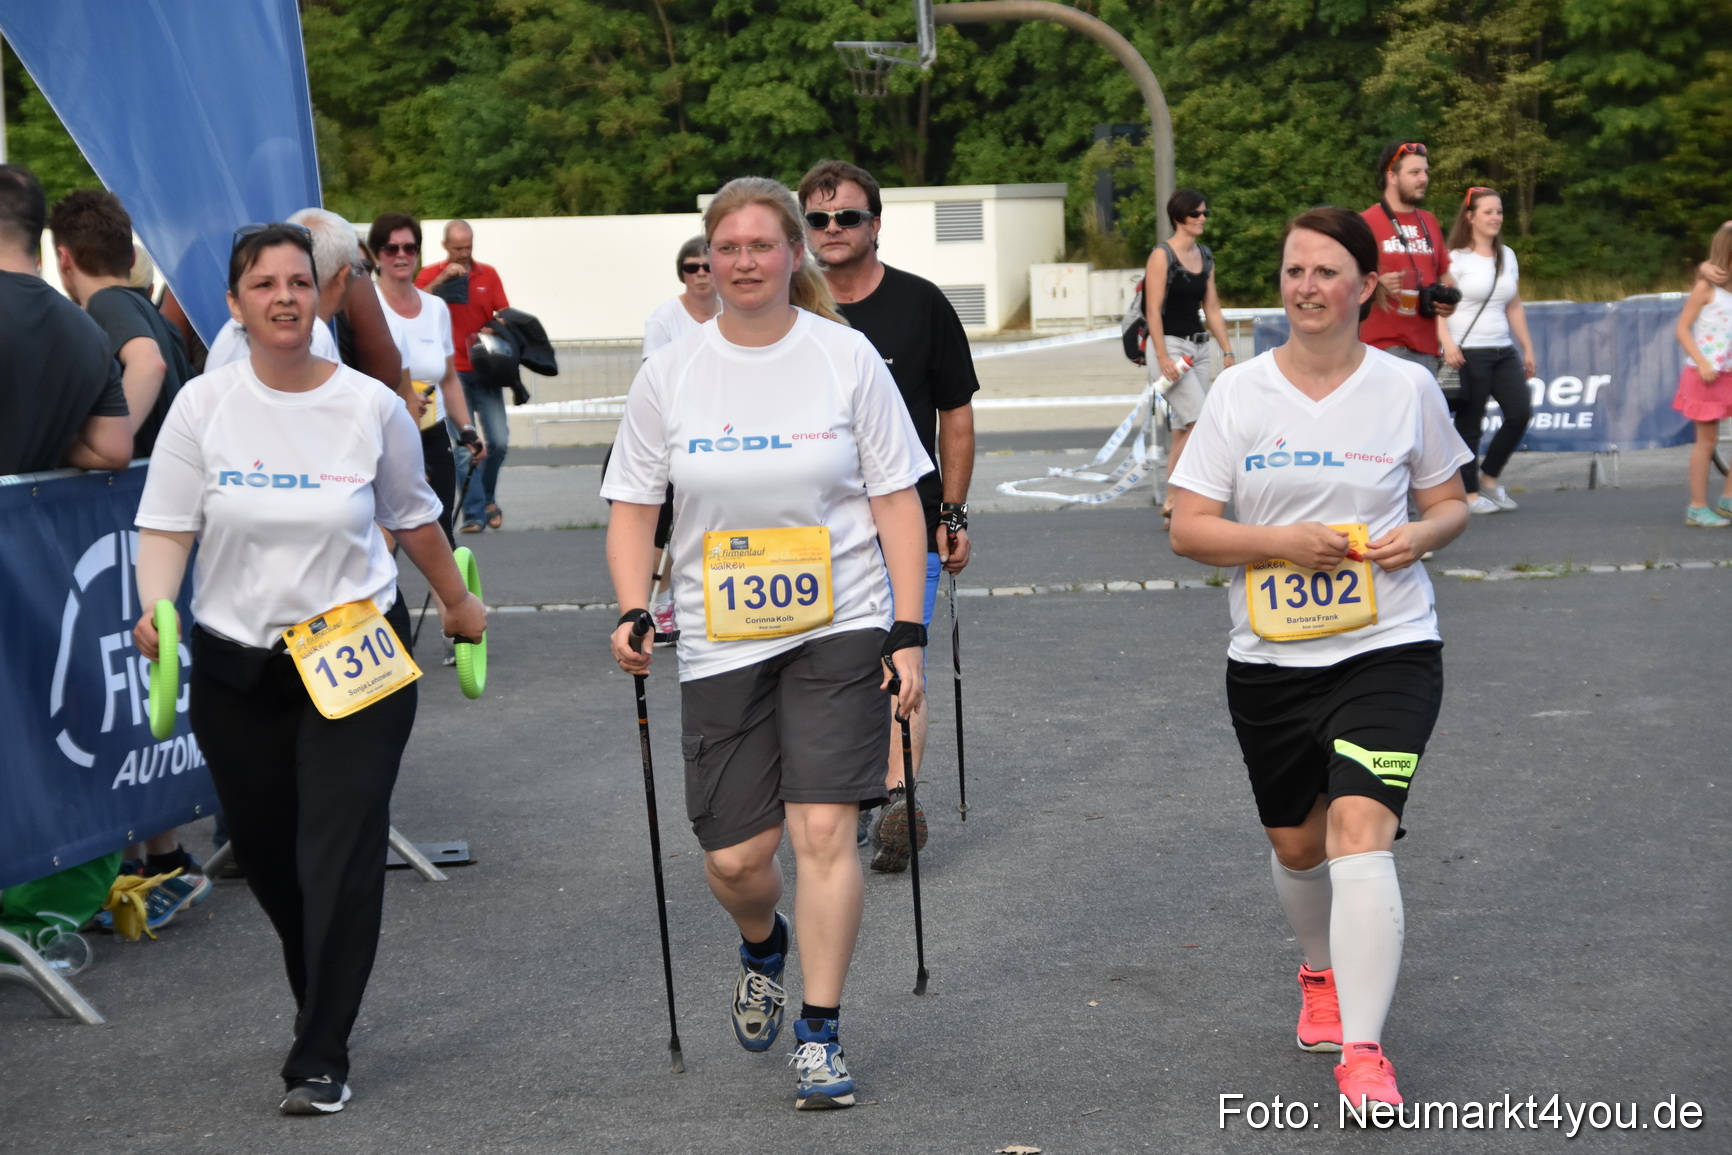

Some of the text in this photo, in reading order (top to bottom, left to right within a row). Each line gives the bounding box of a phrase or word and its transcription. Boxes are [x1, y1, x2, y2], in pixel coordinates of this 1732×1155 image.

[718, 572, 819, 611] 1309
[1260, 569, 1362, 611] 1302
[745, 614, 795, 625] Corinna Kolb
[1286, 613, 1340, 624] Barbara Frank
[314, 626, 396, 689] 1310
[347, 683, 368, 697] Sonja
